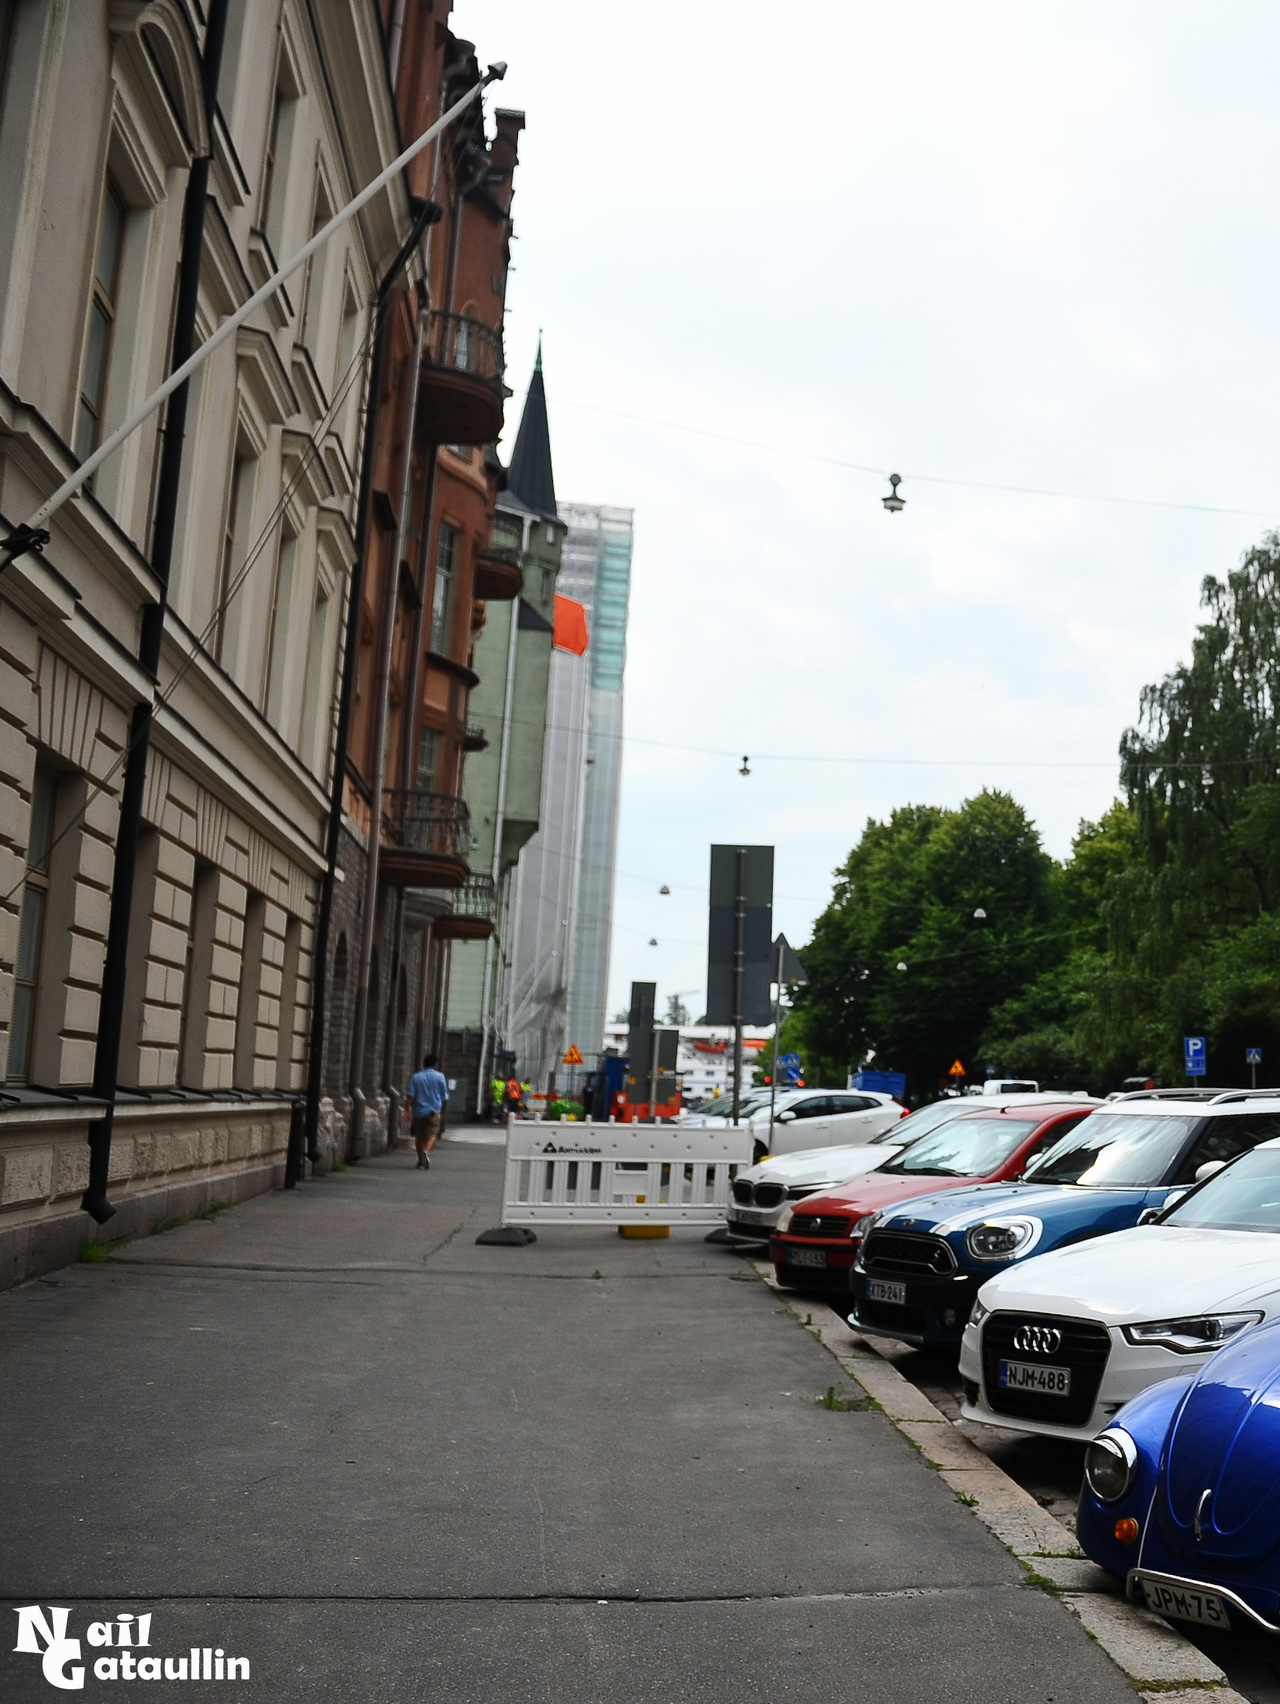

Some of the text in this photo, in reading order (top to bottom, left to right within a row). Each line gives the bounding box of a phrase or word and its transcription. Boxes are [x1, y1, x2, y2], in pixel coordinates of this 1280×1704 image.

[1188, 1039, 1202, 1056] P
[1008, 1366, 1066, 1391] NJM-488
[1151, 1586, 1221, 1622] JPM-75
